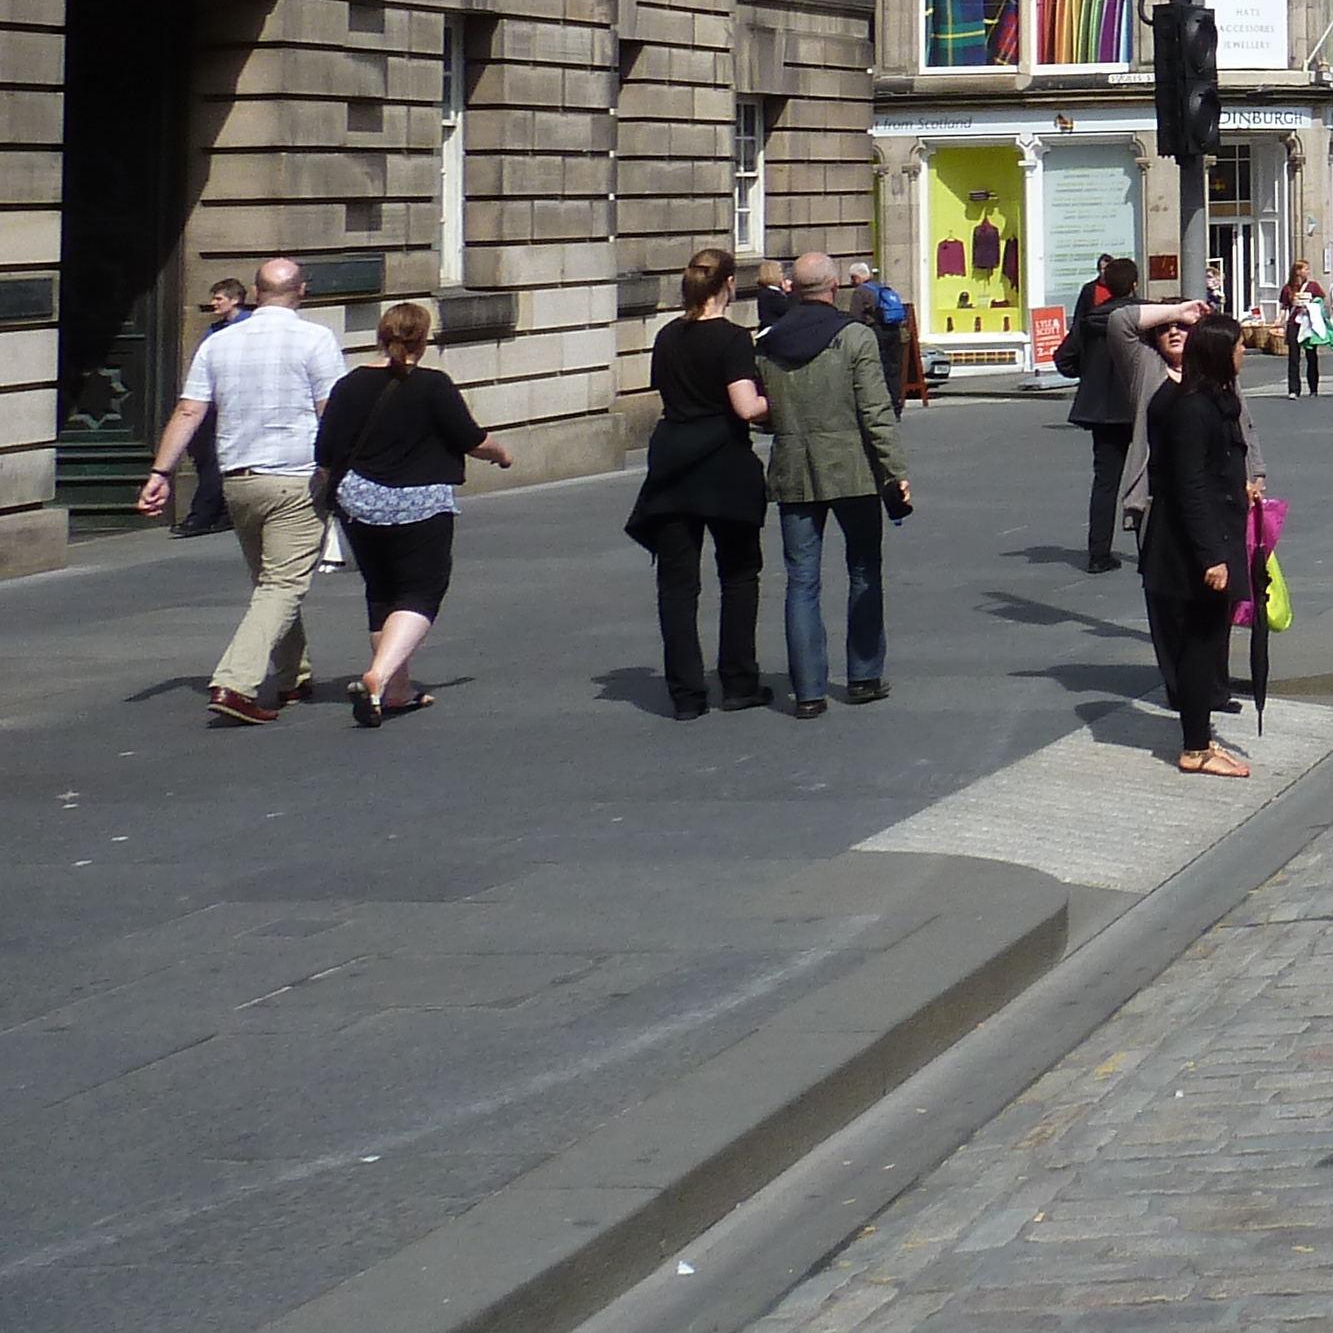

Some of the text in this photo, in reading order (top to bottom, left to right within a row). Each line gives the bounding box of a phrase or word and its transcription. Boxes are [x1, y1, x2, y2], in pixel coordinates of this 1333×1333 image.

[1236, 8, 1260, 16] HATS
[1219, 24, 1274, 33] ACCESSORIES
[1223, 40, 1270, 49] JEWELLERY
[1220, 111, 1303, 126] DINBURGH
[884, 118, 912, 131] from
[918, 117, 973, 130] Scotland
